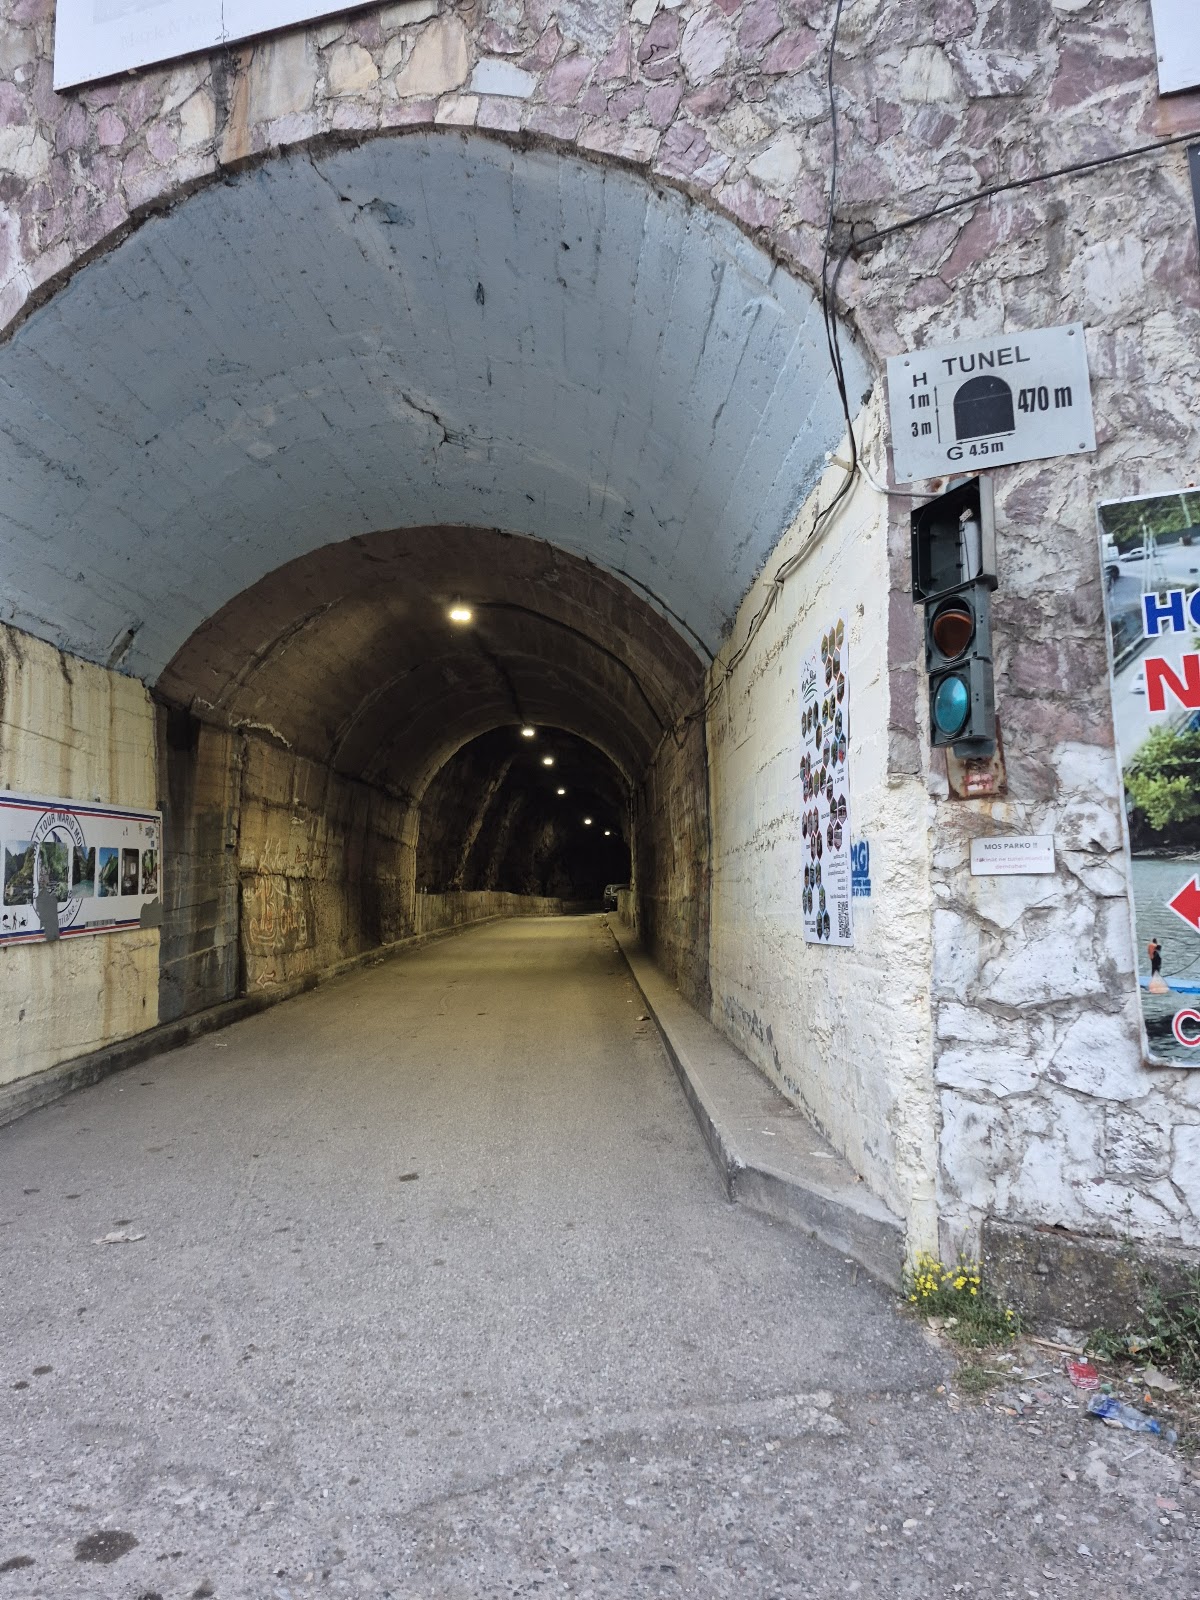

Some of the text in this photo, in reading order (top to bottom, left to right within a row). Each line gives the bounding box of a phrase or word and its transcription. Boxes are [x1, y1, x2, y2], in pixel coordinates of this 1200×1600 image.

[942, 345, 1030, 376] TUNEL
[912, 372, 928, 388] H
[1018, 385, 1072, 413] 470 m
[946, 445, 964, 461] G
[39, 813, 56, 834] TOUR
[57, 811, 75, 831] MARIO
[1003, 842, 1031, 850] PARKO
